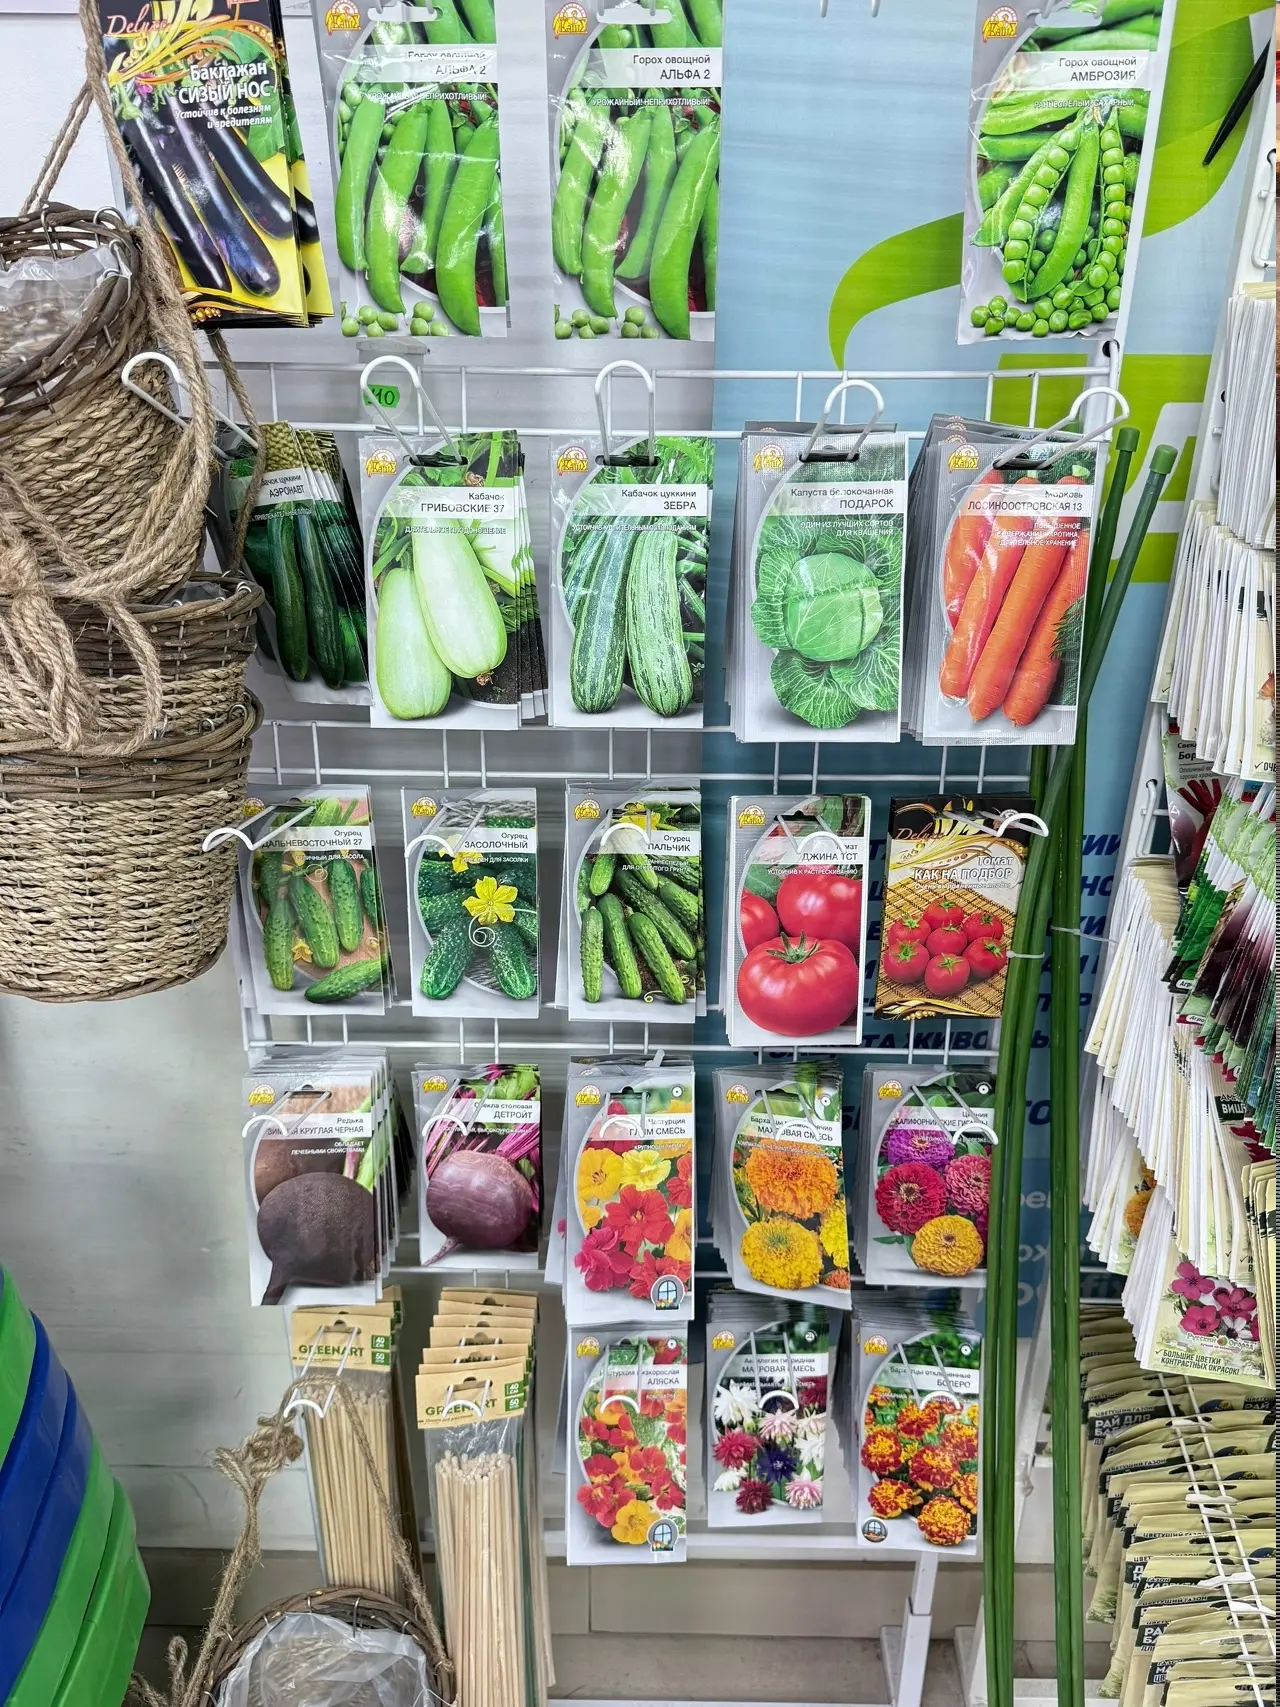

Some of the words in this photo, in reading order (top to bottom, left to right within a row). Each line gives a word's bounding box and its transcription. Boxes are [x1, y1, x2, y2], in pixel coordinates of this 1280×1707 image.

[107, 3, 169, 35] Deluxe
[633, 55, 663, 66] Горох
[665, 54, 710, 65] овощной
[1059, 57, 1088, 67] Горох
[1091, 56, 1137, 67] овощной
[190, 62, 268, 81] Баклажан
[435, 64, 477, 75] АЛЬФА
[479, 65, 486, 75] 2
[660, 69, 700, 80] АЛЬФА
[704, 70, 710, 80] 2
[1070, 71, 1136, 82] АМБРОЗИЯ
[178, 80, 233, 104] СИЗЫЙ
[237, 80, 271, 98] НОС
[421, 92, 487, 101] ЕПРИХОТЛИВЫЙ!
[593, 97, 642, 106] УРОЖАЙНЫЙ!
[643, 97, 710, 106] НЕПРИХОТЛИВЫЙ!
[175, 108, 218, 119] Устойчив
[227, 104, 272, 115] болезням
[214, 116, 273, 128] вредителям
[367, 388, 395, 406] 10
[269, 485, 305, 498] АЭРОНАВТ
[621, 490, 658, 498] Кабачок
[660, 490, 697, 499] цуккини
[791, 489, 827, 498] Капуста
[468, 493, 505, 502] Кабачок
[421, 503, 491, 513] ГРИБОВСКИЕ
[493, 503, 505, 513] 37
[663, 501, 697, 510] ЗЕБРА
[840, 499, 894, 510] ПОДАРОК
[967, 502, 1071, 511] ЛОСИНООСТРОВСКАЯ
[1072, 503, 1082, 511] 13
[801, 521, 821, 529] ОДИН
[834, 521, 863, 529] ЛУЧШИХ
[864, 520, 893, 528] СОРТОВ
[836, 529, 852, 537] ДЛЯ
[853, 529, 893, 537] КВАШЕНИЯ
[333, 830, 362, 838] Огурец
[501, 832, 528, 840] Огурец
[895, 822, 945, 841] Deluxe
[262, 838, 352, 849] ДАЛЬНЕВОСТОЧНЫЙ
[353, 838, 363, 846] 27
[663, 835, 691, 843] Огурец
[464, 840, 528, 849] ЗАСОЛОЧНЫЙ
[648, 843, 691, 852] ПАЛЬЧИК
[802, 853, 838, 862] ДЖИНА
[841, 852, 858, 861] ТСТ
[978, 856, 1014, 866] Томат
[914, 869, 940, 881] КАК
[942, 869, 959, 880] НА
[961, 868, 1013, 882] ПОДБОР
[494, 1110, 532, 1120] ДЕТРОЙТ
[750, 1116, 782, 1126] Бархацы
[300, 1127, 334, 1136] КРУГЛАЯ
[335, 1126, 364, 1134] ЧЕРНАЯ
[656, 1127, 686, 1135] СМЕСЬ
[376, 1336, 385, 1344] 40
[1163, 1350, 1194, 1360] БОЛЬШИЕ
[1195, 1354, 1221, 1364] ЦВЕТКИ
[742, 1365, 786, 1373] МАРОВАЯ
[787, 1364, 816, 1373] МЕСЬ
[890, 1366, 924, 1376] Бархтцы
[1161, 1357, 1207, 1370] КОНТРАСТНЫХ
[1208, 1363, 1240, 1375] ОКРАСОК!
[1095, 1415, 1120, 1429] РАЙ
[1124, 1414, 1151, 1425] ДЛЯ
